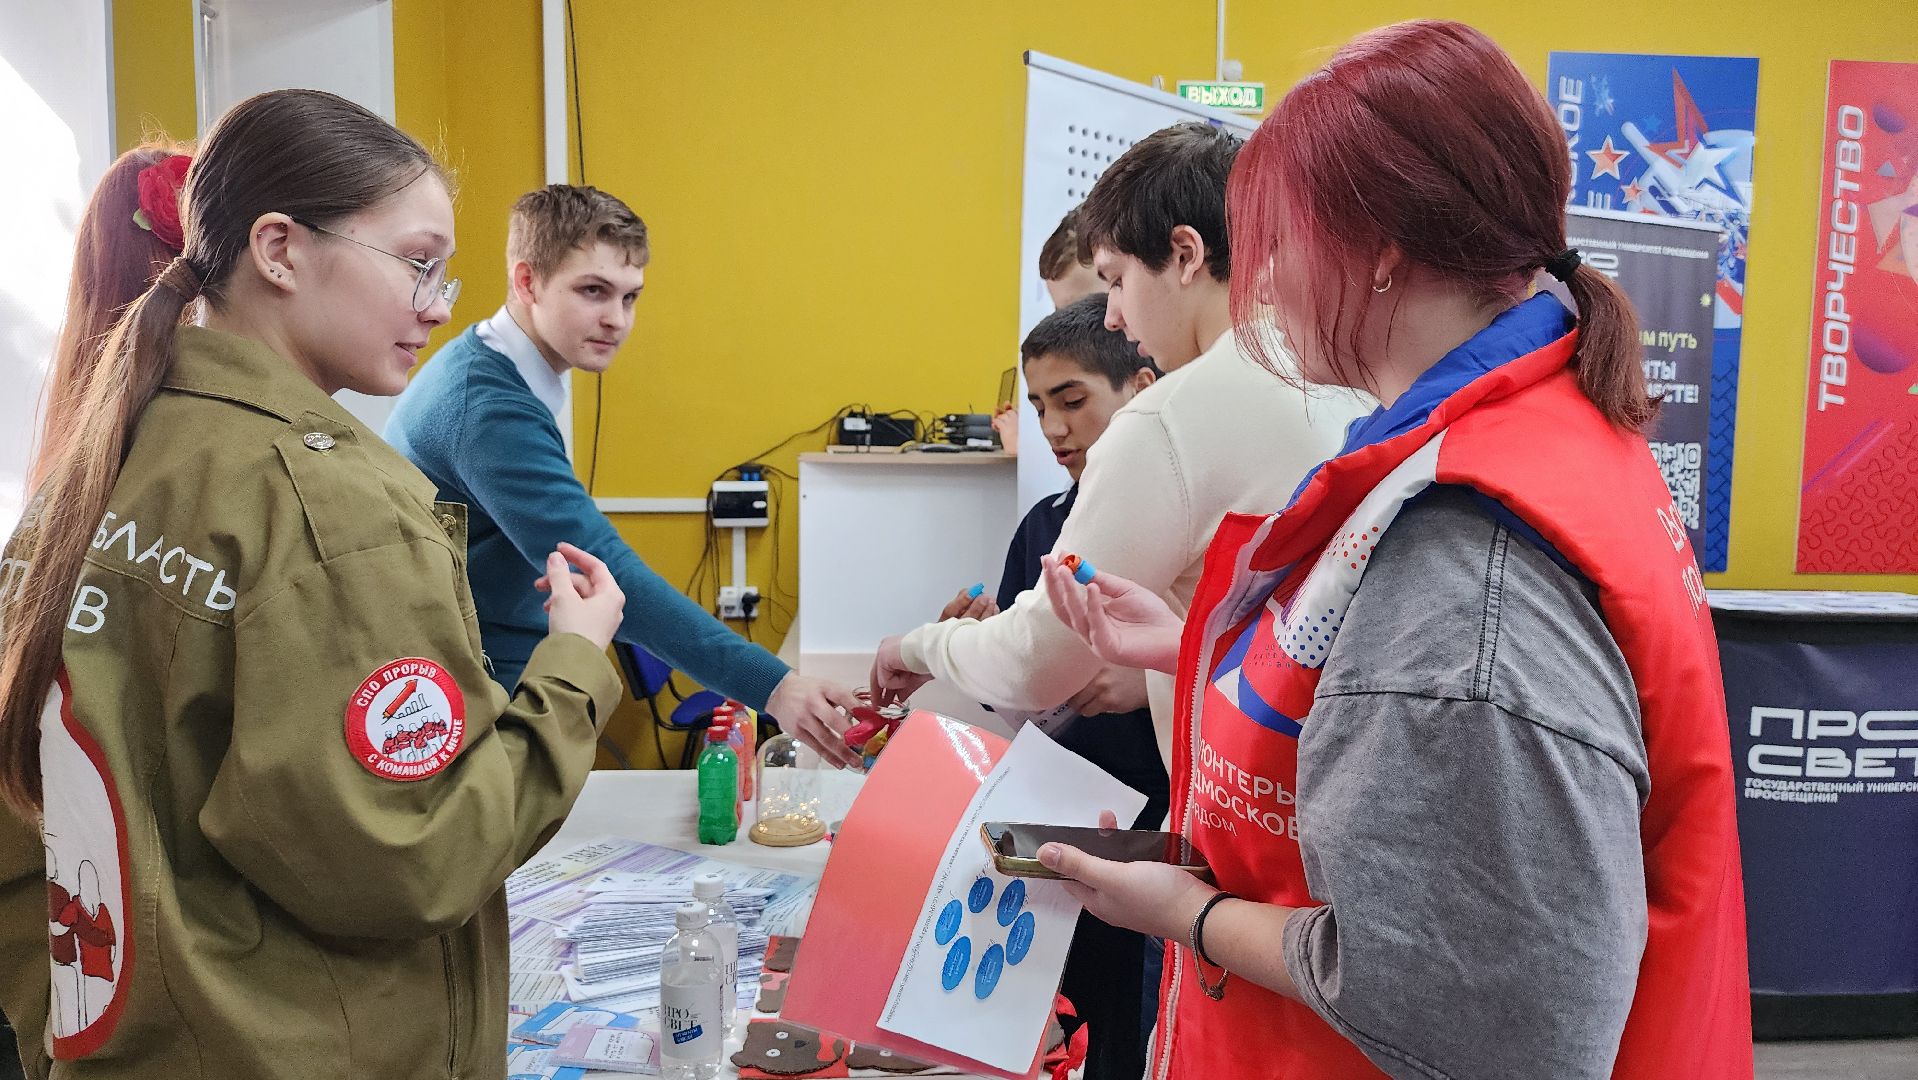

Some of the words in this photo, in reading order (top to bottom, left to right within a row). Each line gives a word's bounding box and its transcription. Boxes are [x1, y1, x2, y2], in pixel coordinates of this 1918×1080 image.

[1186, 85, 1257, 107] ВЫХОД
[1817, 104, 1864, 412] ТВОРЧЕСТВО
[92, 511, 237, 611] БЛАСТЬ
[67, 585, 109, 634] В
[356, 680, 381, 707] СПО
[382, 663, 437, 683] ПРОРЫВ
[367, 753, 378, 763] С
[376, 756, 441, 776] КОМАНДОЙ
[438, 751, 451, 762] К
[445, 718, 463, 752] МЕЧТЕ
[1744, 788, 1838, 803] ПРОСВЕЩЕНИЯ
[1745, 778, 1863, 793] ГОСУДАРСТВЕННЫЙ
[1193, 801, 1237, 837] ЯДОМ
